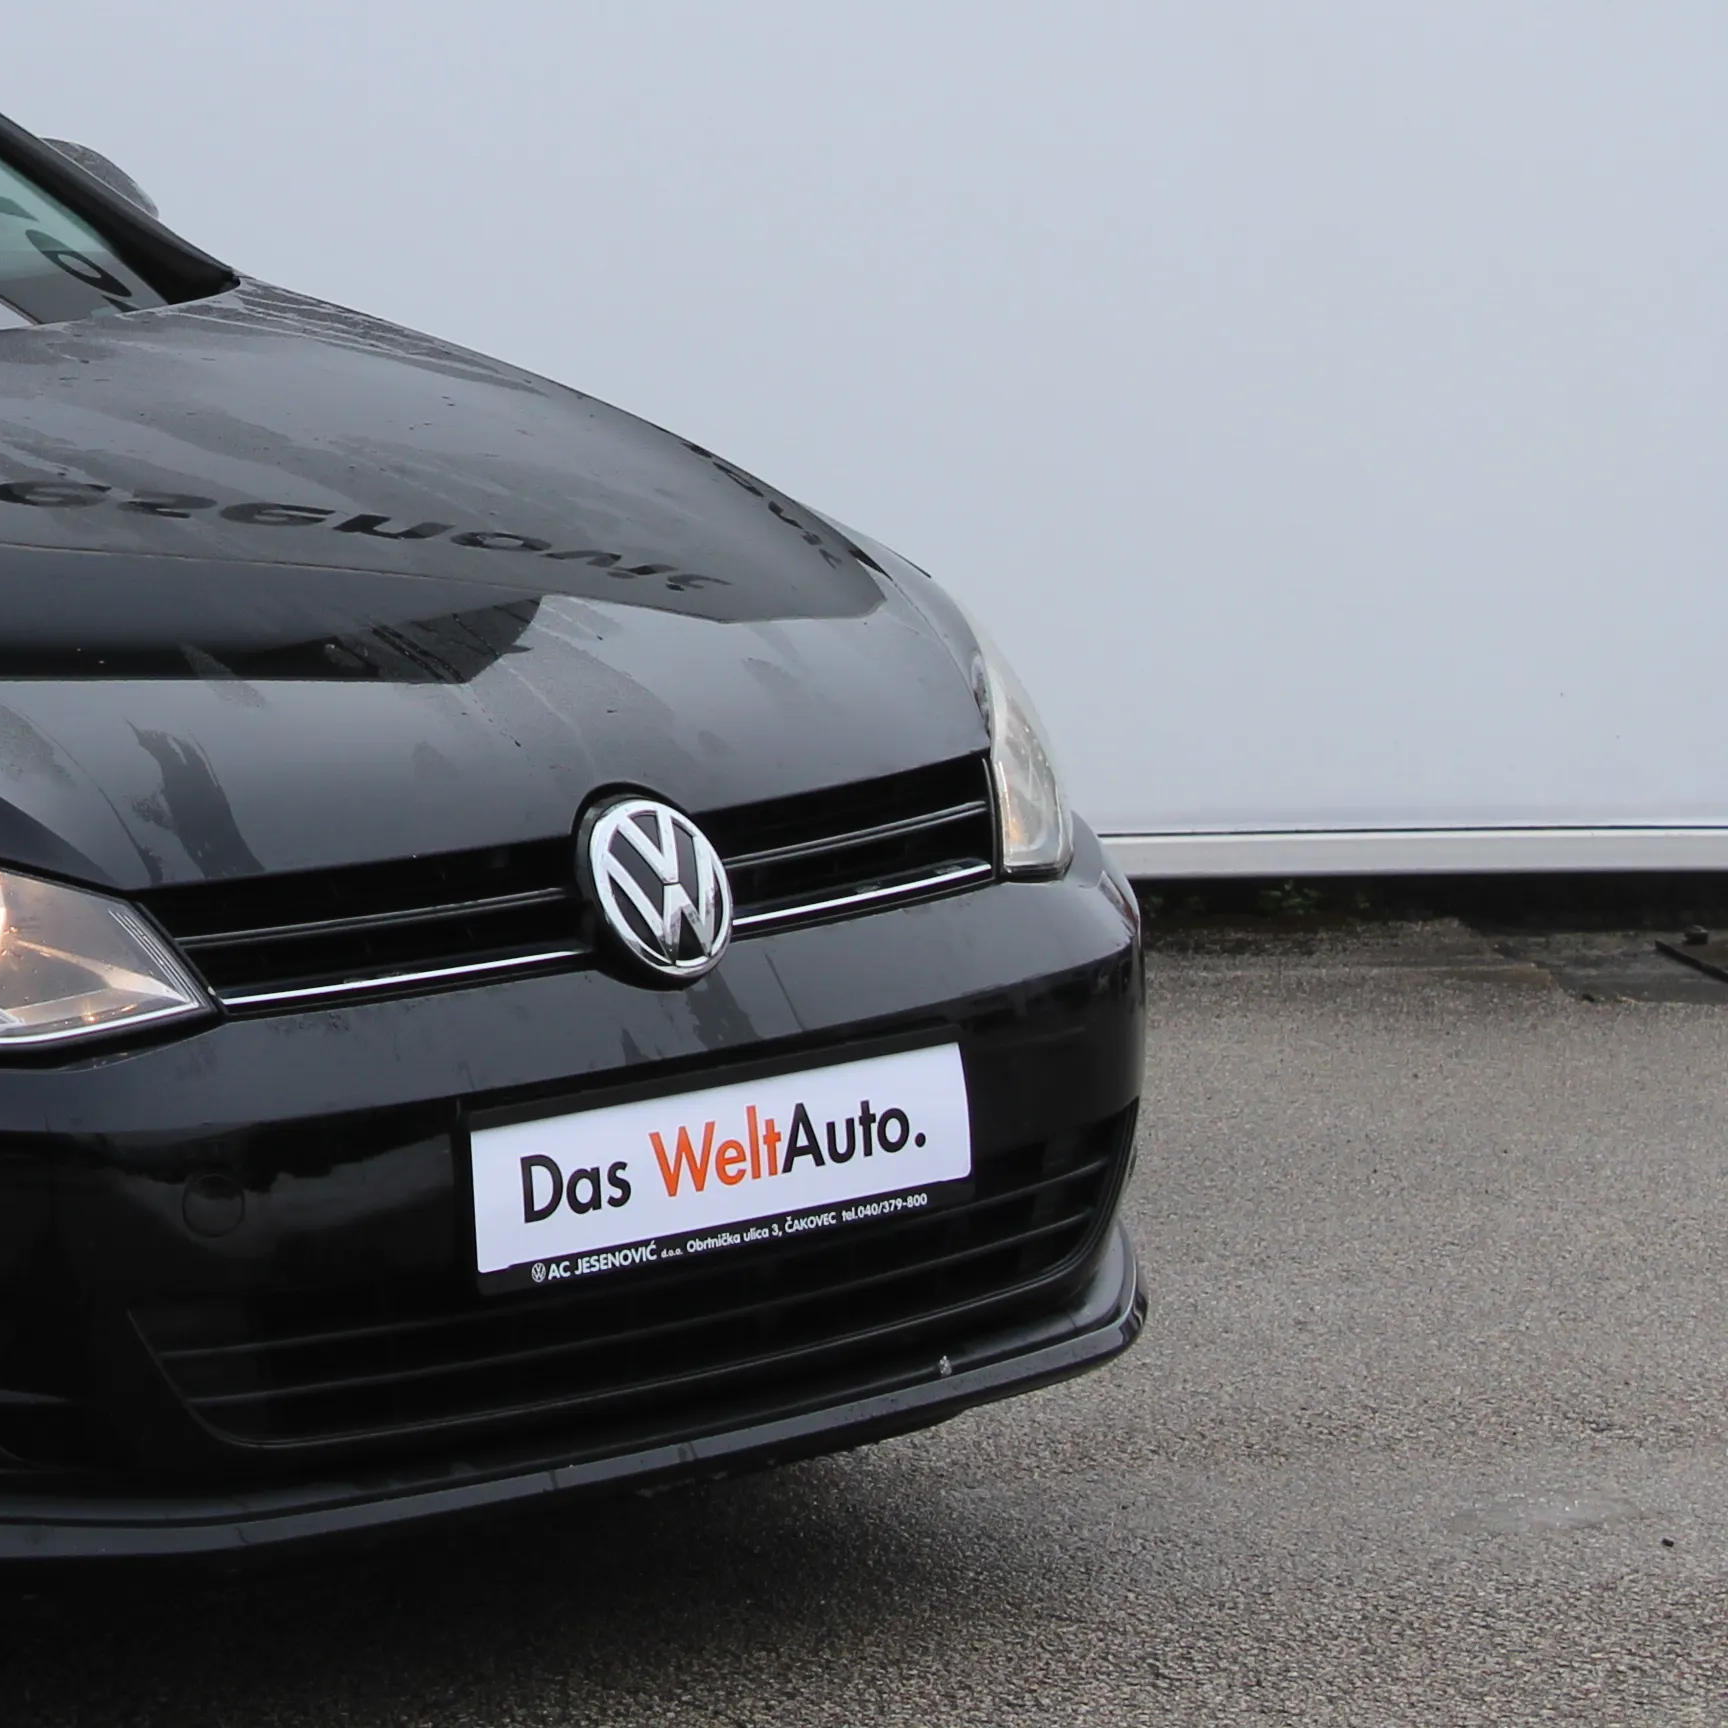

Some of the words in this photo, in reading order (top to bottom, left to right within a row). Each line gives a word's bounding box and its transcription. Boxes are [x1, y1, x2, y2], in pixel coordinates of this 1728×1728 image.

[519, 1153, 632, 1224] Das
[648, 1099, 927, 1197] WeltAuto.
[547, 1261, 572, 1281] AC
[574, 1240, 658, 1275] JESENOVIĆ
[660, 1247, 684, 1260] d.o.o.
[686, 1231, 741, 1254] Obrtnička
[743, 1226, 770, 1243] ulica
[771, 1223, 784, 1239] 3,
[784, 1212, 837, 1234] ČAKOVEC
[841, 1192, 929, 1223] tel.040/379-800
